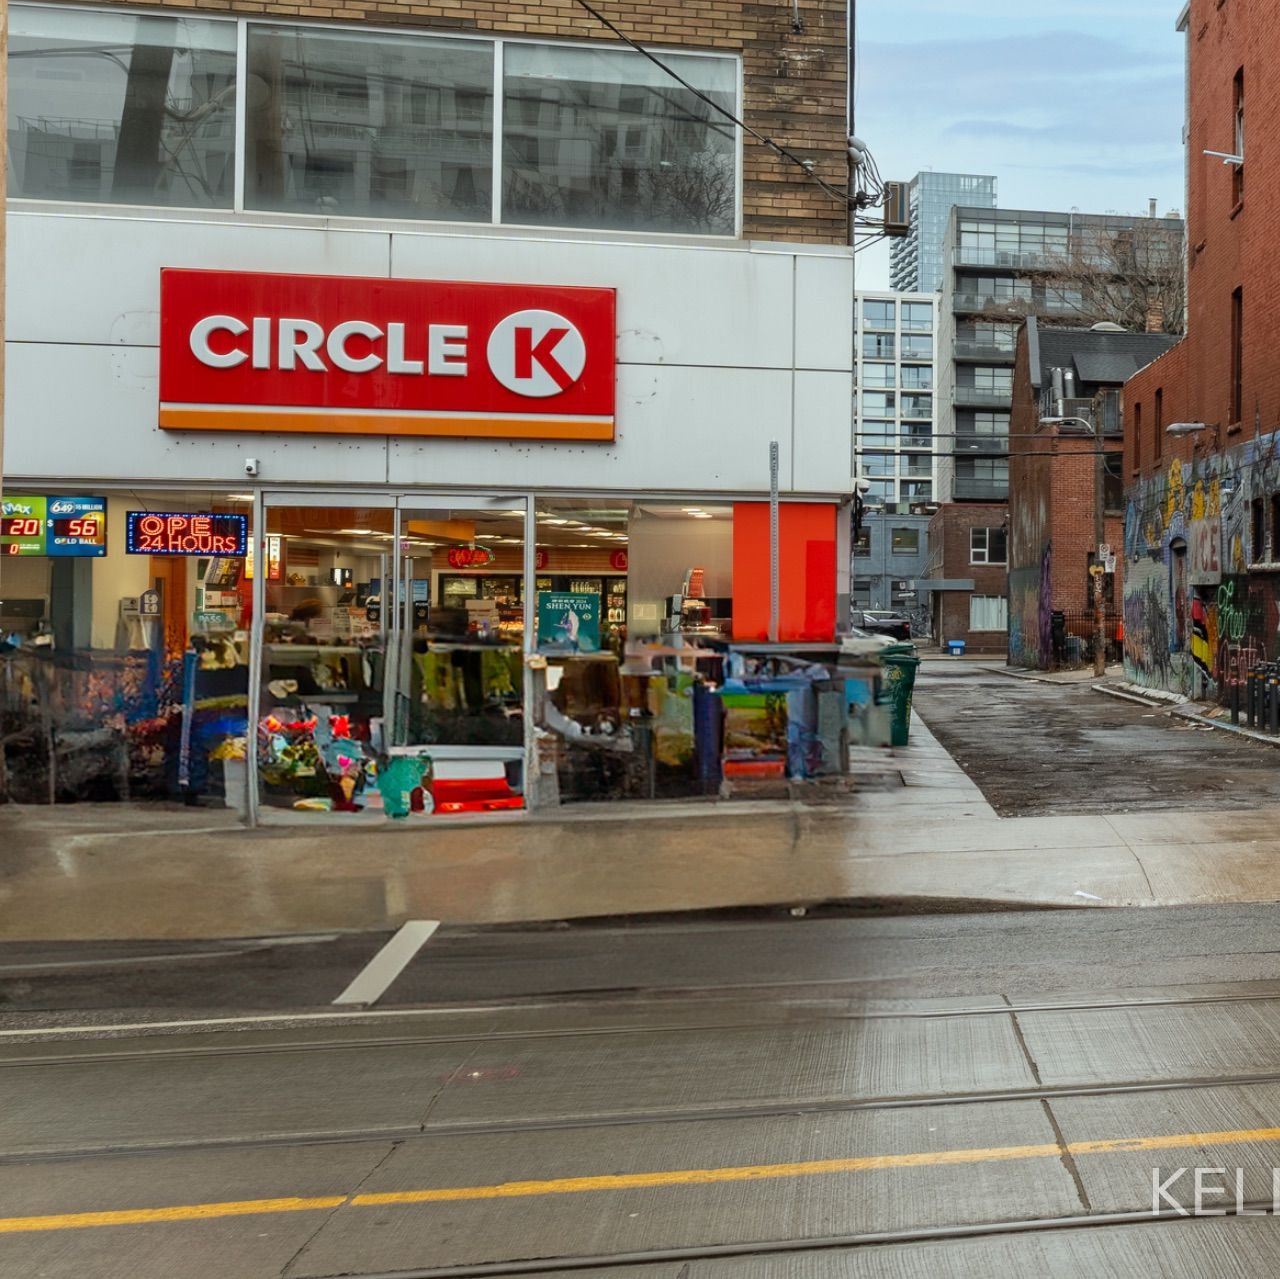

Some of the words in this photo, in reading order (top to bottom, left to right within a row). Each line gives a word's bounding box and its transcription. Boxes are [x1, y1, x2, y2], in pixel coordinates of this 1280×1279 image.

[189, 314, 468, 377] CIRCLE
[514, 326, 577, 392] K
[9, 519, 39, 535] 20
[69, 520, 96, 536] 56
[140, 535, 164, 550] 24
[169, 535, 236, 552] HOURS
[546, 602, 570, 610] SHEN
